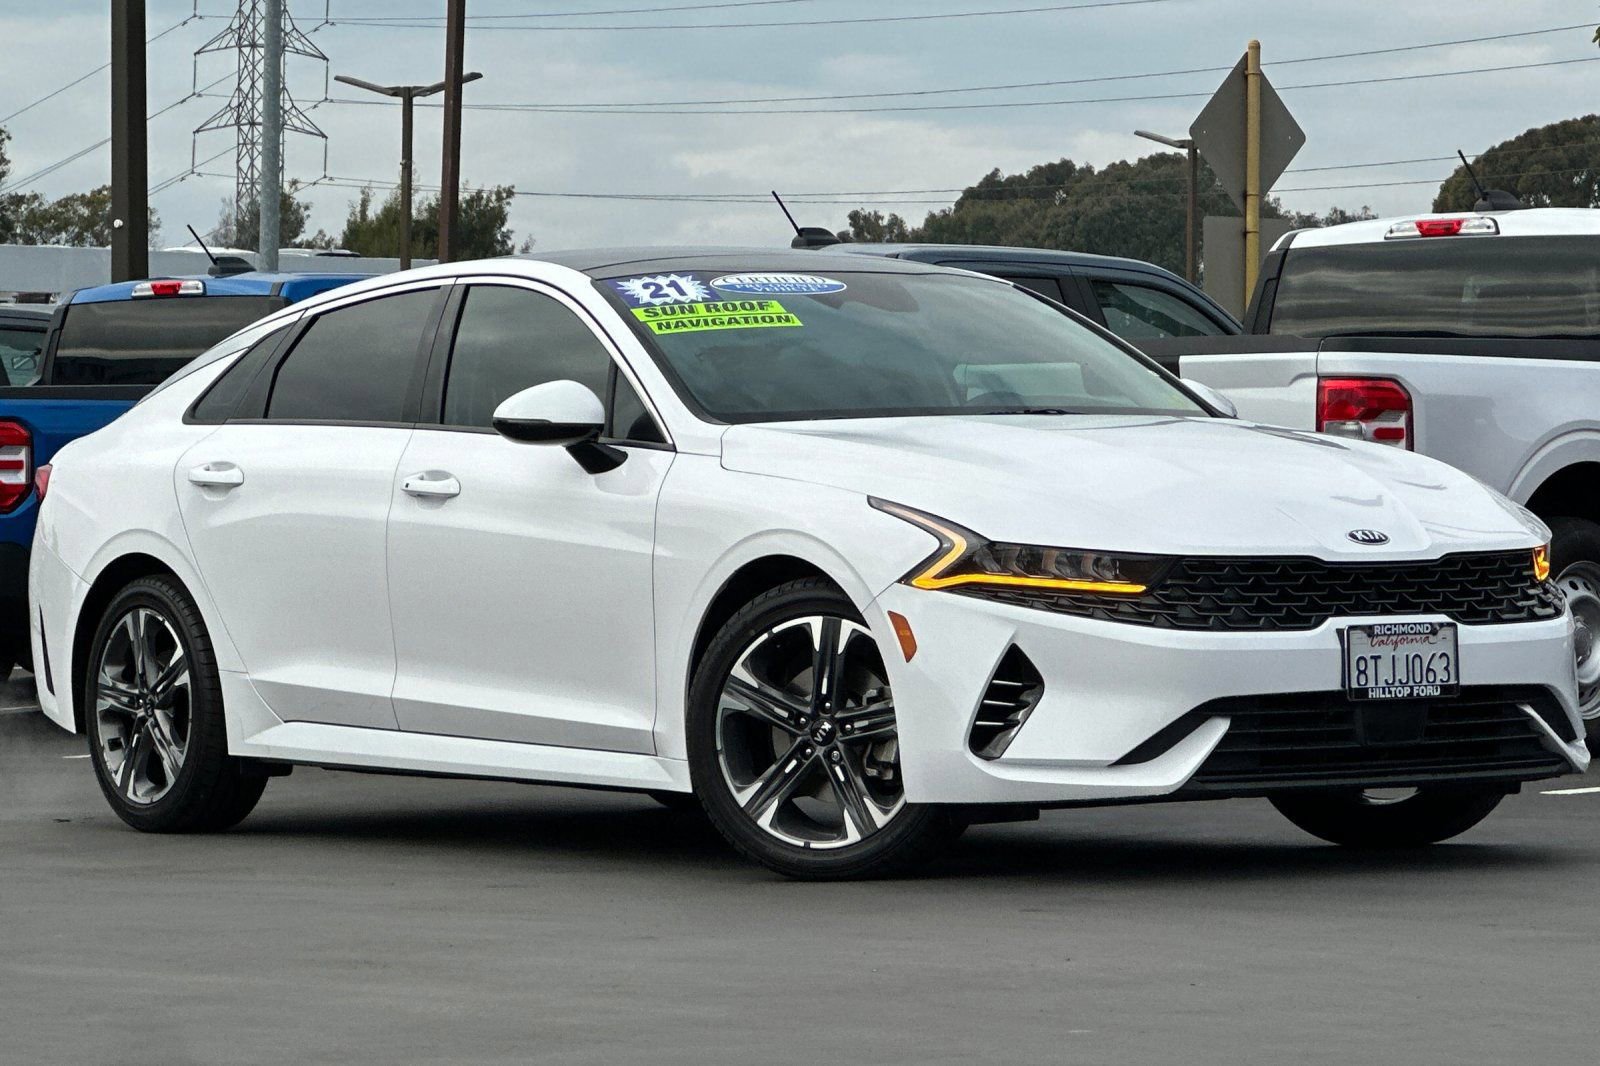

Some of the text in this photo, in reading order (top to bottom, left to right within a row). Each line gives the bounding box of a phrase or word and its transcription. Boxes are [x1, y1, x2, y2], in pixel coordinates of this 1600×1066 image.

[641, 279, 688, 299] 21
[643, 300, 775, 318] SUN ROOF
[657, 315, 794, 330] NAVIGATION
[1353, 529, 1387, 541] KIA
[1374, 623, 1431, 635] RICHMOND
[1370, 635, 1437, 651] California
[1356, 652, 1450, 687] 8TJJ063
[1368, 685, 1441, 699] HILLTOP FORD
